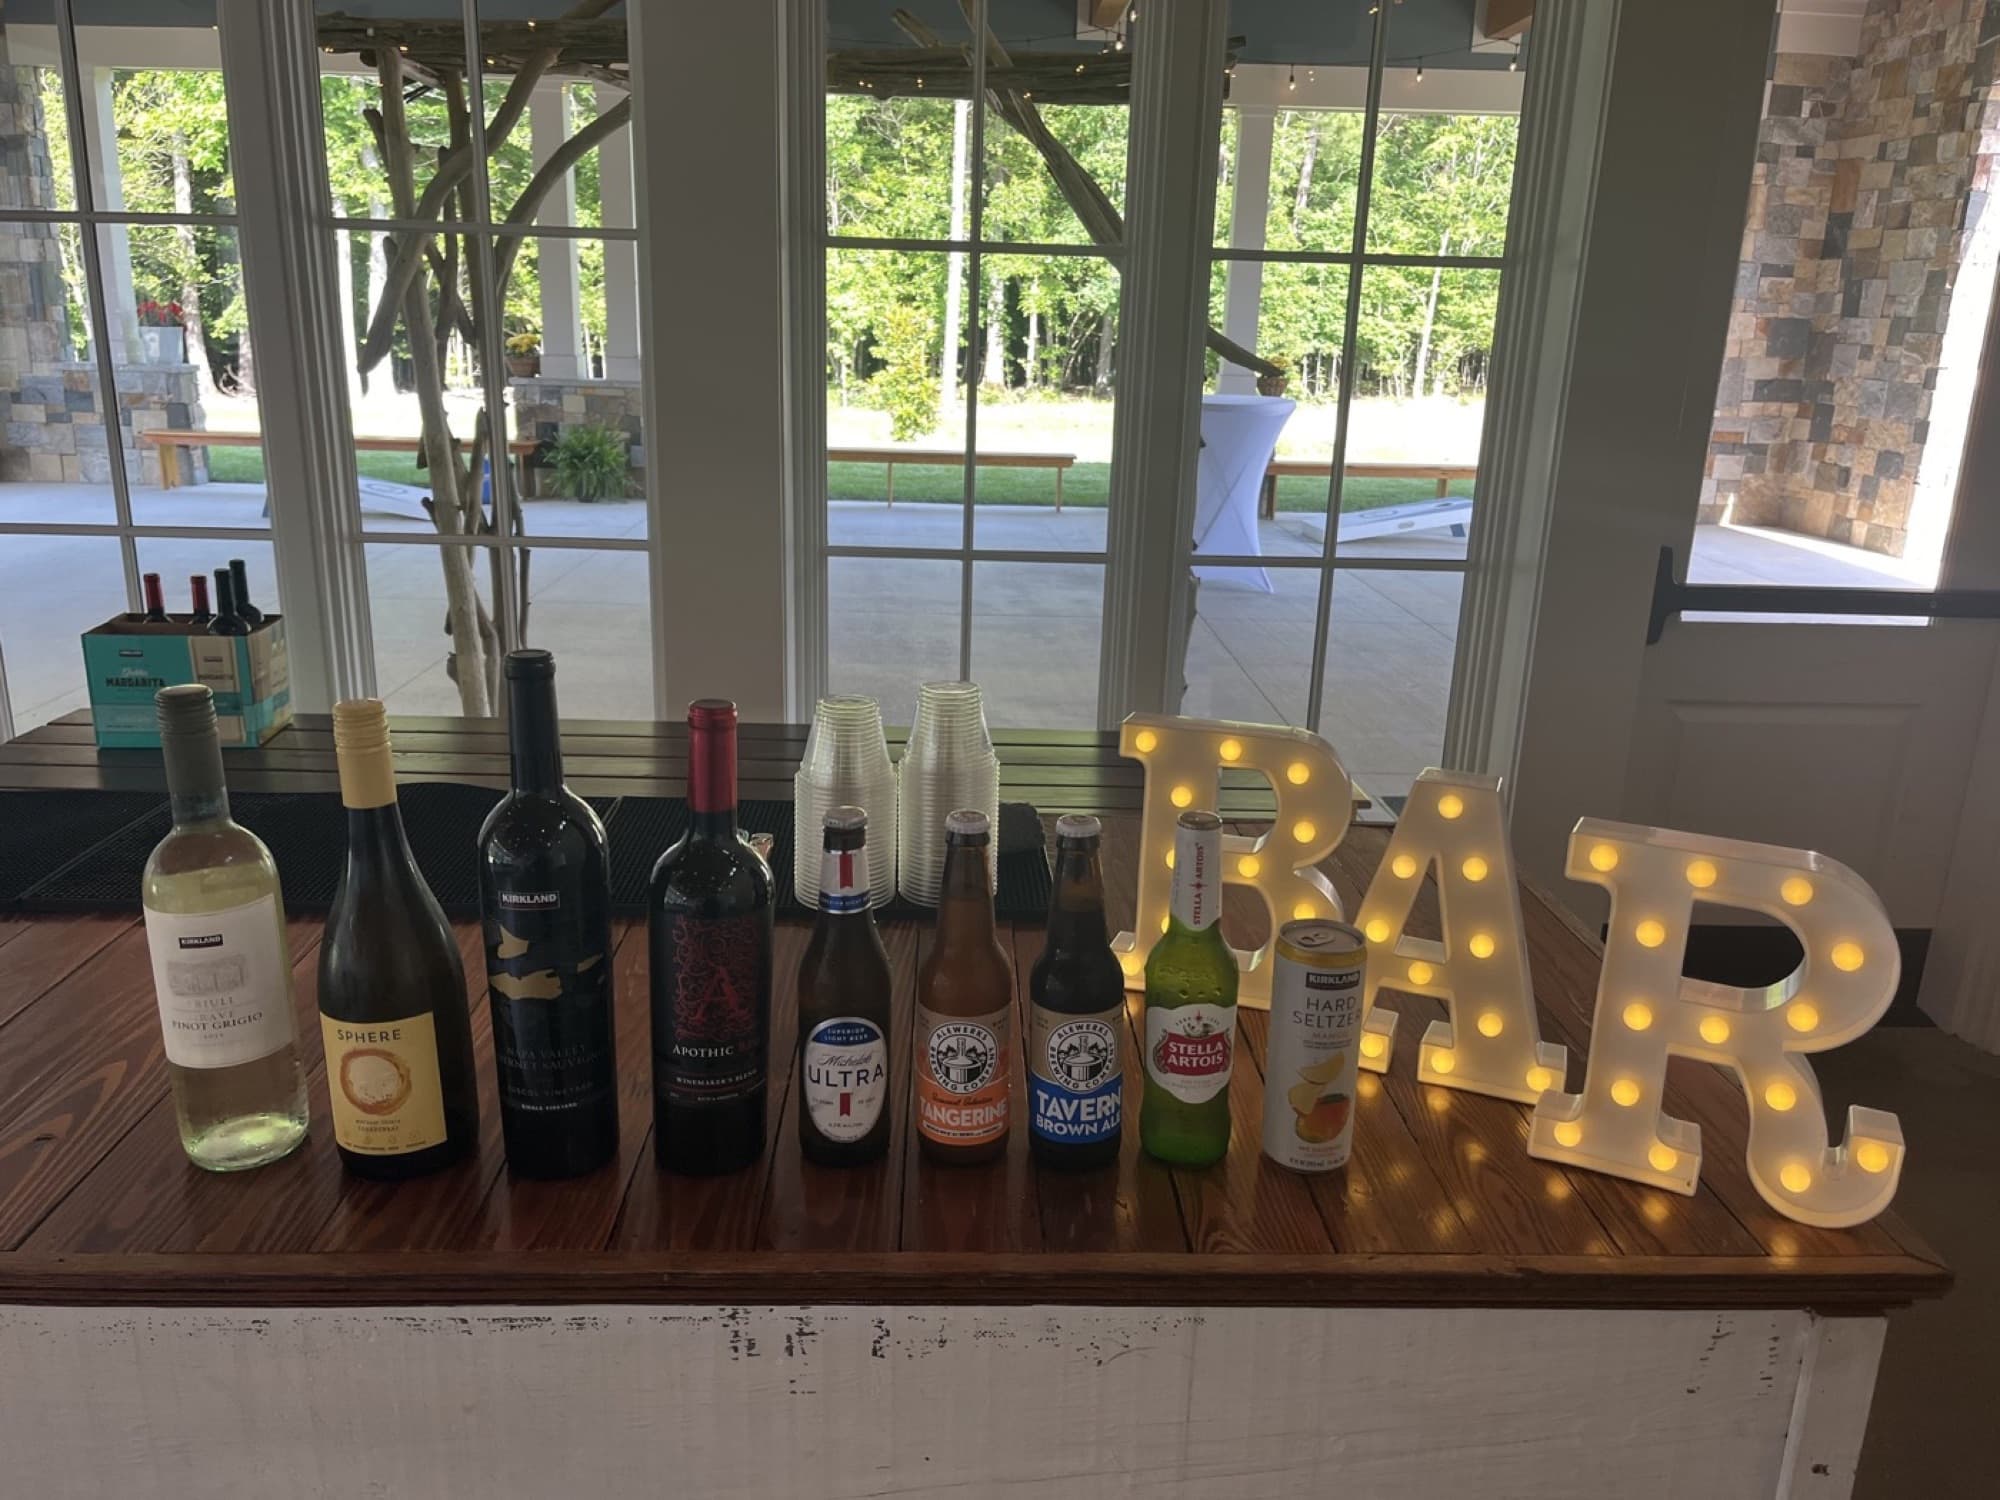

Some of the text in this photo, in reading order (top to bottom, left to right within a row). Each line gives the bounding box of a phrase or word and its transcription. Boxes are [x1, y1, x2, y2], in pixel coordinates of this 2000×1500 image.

[105, 677, 166, 688] MARGARITA
[502, 893, 557, 904] KIRKLAND
[181, 936, 221, 945] KIRKLAND
[1110, 712, 1905, 1228] BAR
[1309, 973, 1359, 984] KIRKLAND
[1306, 996, 1356, 1012] HARD
[171, 1011, 263, 1031] PINOT GRIGIO
[336, 1029, 401, 1043] SPHERE
[936, 1026, 988, 1041] ALEWERKS
[1057, 1023, 1109, 1040] ALEWERKS
[672, 1044, 734, 1058] APOTHIC
[1168, 1041, 1223, 1055] STELLA
[1167, 1053, 1223, 1068] ARTOIS
[808, 1063, 884, 1088] ULTRA
[1036, 1085, 1121, 1121] TAVERN
[919, 1095, 1007, 1127] TANGERINE
[1036, 1113, 1098, 1137] BROWN
